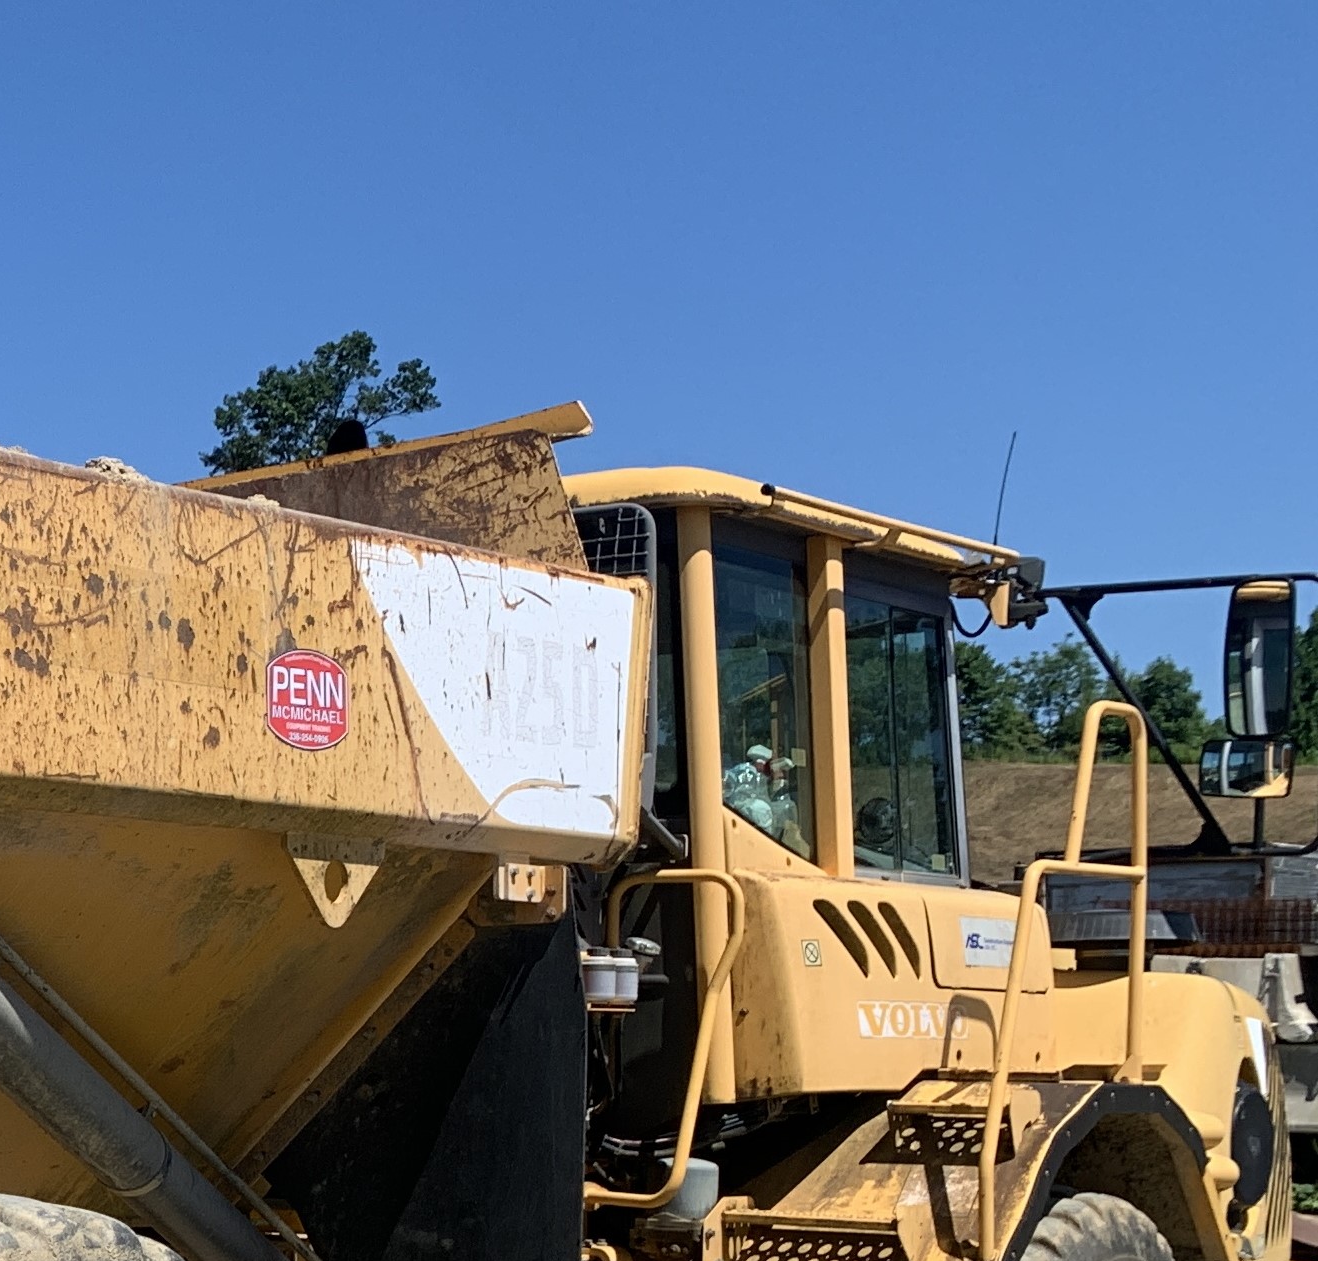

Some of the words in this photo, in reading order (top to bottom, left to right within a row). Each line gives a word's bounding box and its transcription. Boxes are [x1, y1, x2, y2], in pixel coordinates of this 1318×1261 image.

[272, 665, 343, 709] PENN
[479, 630, 598, 748] A25D
[272, 704, 344, 724] MCMICHAEL
[857, 1002, 968, 1037] VOLVO
